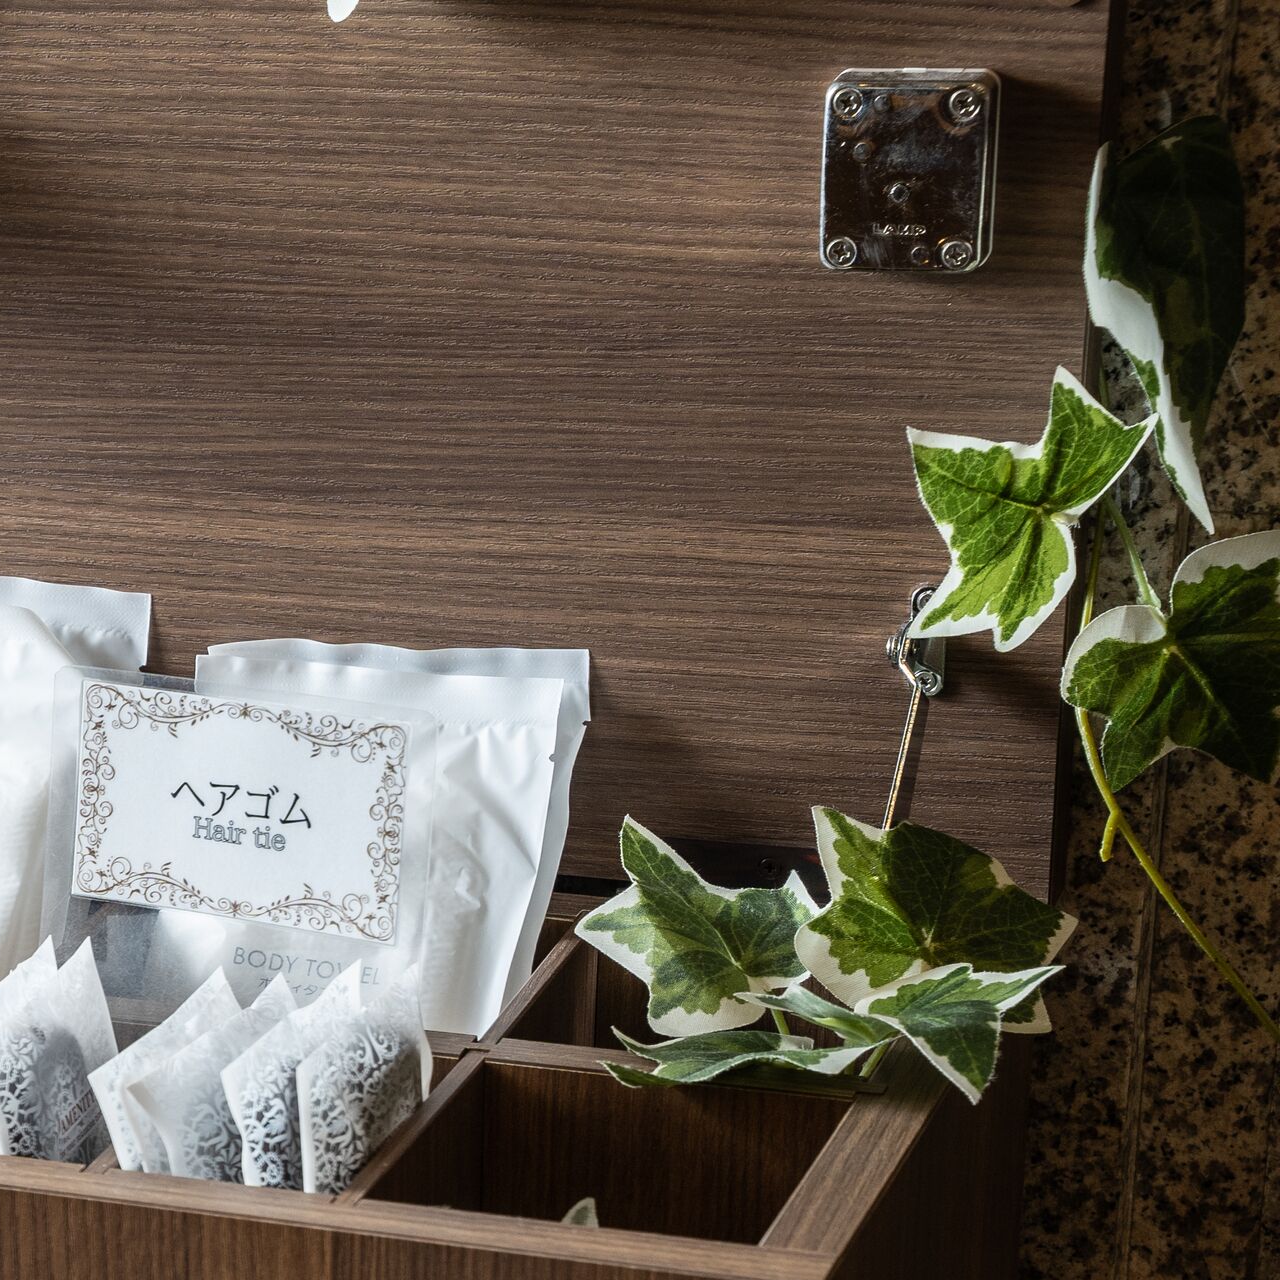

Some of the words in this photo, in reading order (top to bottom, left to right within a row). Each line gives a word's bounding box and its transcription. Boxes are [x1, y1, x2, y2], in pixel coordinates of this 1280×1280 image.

[871, 223, 927, 236] LAMP
[170, 781, 312, 829] ヘアゴム
[192, 816, 247, 845] Hair
[252, 826, 286, 851] tie
[233, 946, 298, 973] BODY
[306, 958, 380, 985] TOEL
